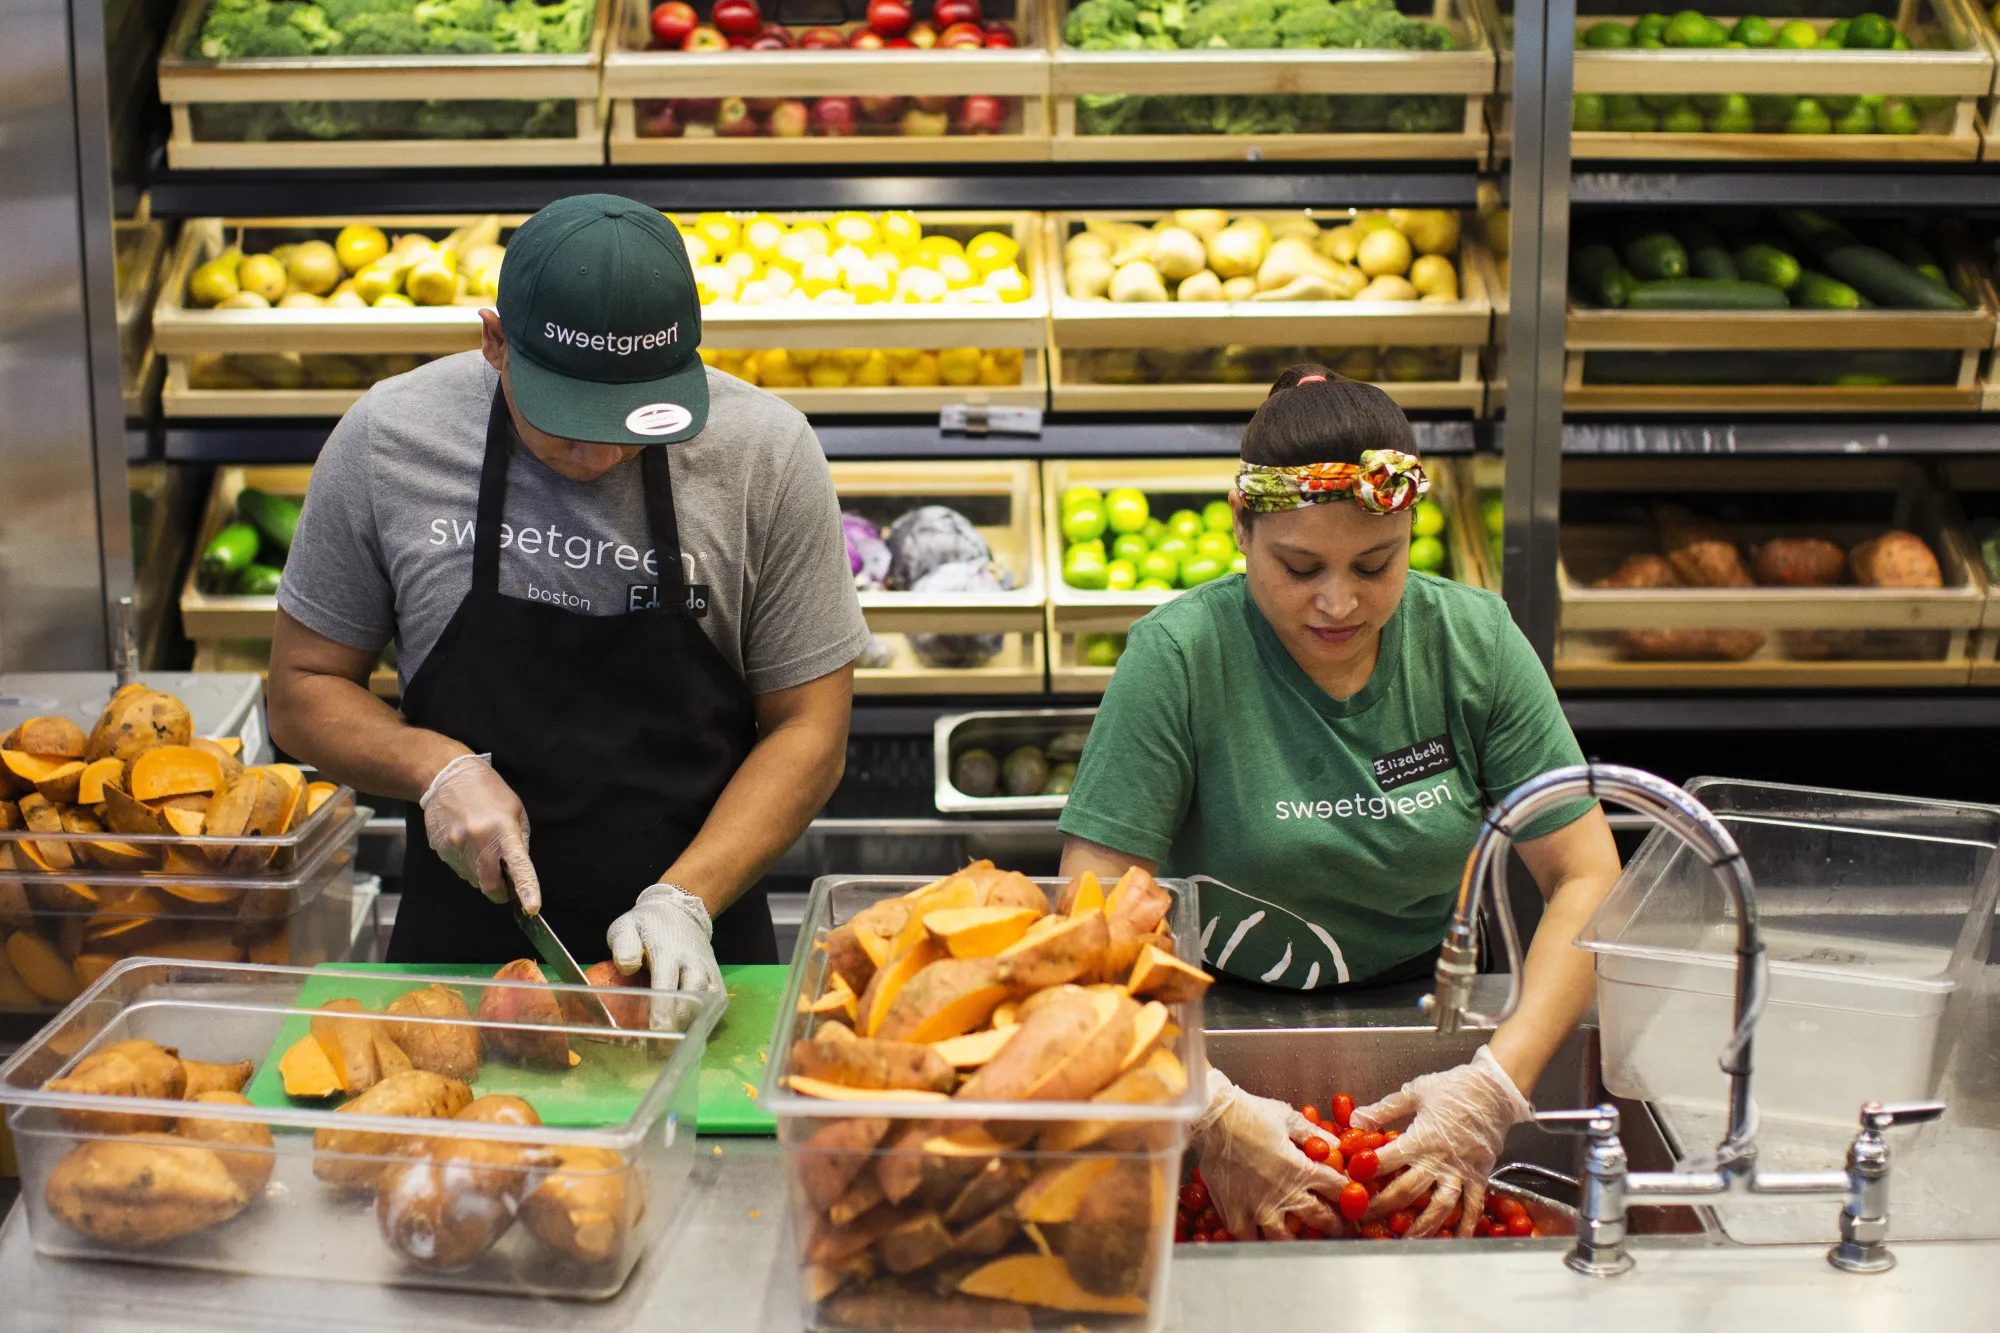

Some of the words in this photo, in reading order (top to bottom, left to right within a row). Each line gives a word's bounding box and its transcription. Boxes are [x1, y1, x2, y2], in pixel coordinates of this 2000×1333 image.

[527, 582, 591, 611] boston
[629, 585, 706, 612] Eddo
[1373, 740, 1445, 776] Elizabeth
